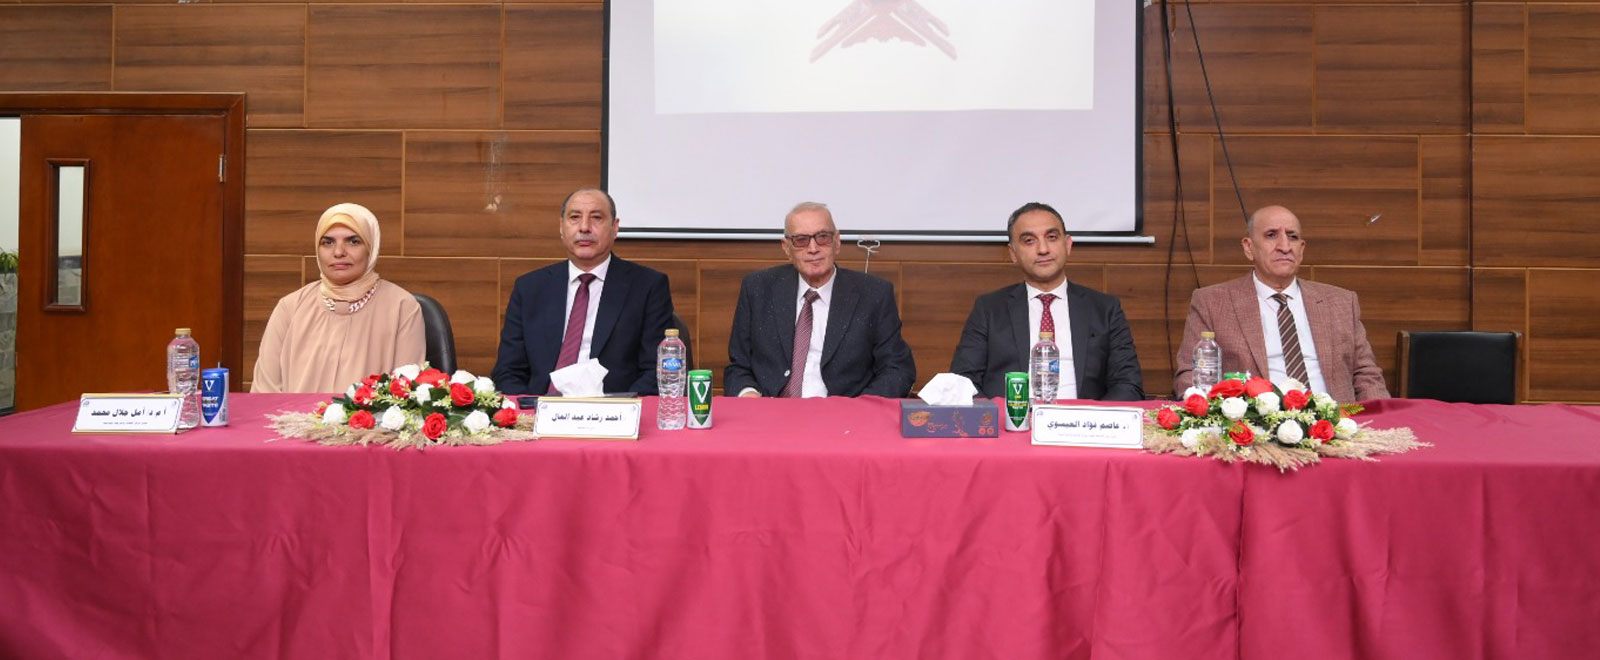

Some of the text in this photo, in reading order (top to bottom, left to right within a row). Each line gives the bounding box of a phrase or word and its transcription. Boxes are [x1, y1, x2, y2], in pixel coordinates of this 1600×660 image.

[204, 380, 215, 391] V
[1013, 384, 1023, 395] V
[692, 381, 711, 403] V
[91, 408, 111, 416] محمد
[112, 408, 129, 417] جلال
[552, 412, 570, 422] العال
[605, 412, 622, 421] أحمد
[587, 413, 603, 423] رشاد
[1047, 420, 1080, 430] العيسوي
[1082, 420, 1097, 430] فؤاد
[1100, 421, 1120, 430] عاصم
